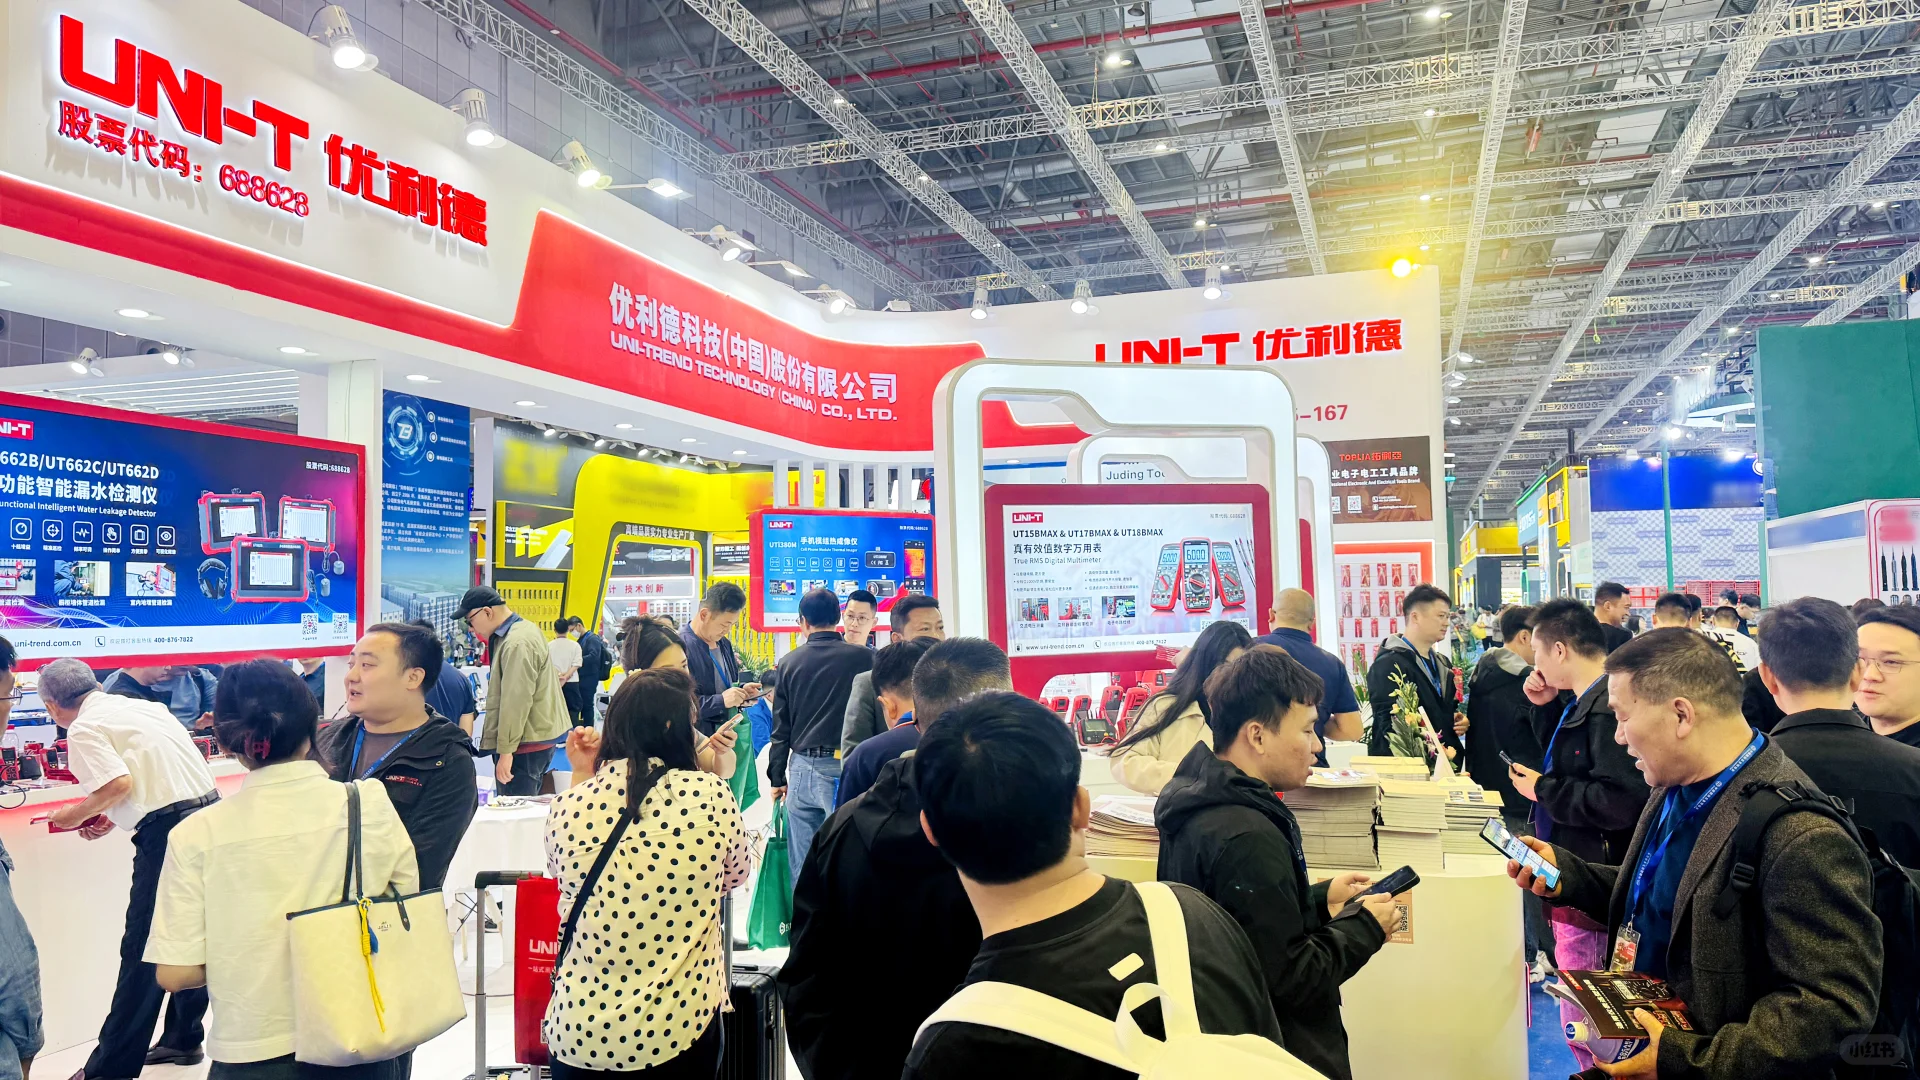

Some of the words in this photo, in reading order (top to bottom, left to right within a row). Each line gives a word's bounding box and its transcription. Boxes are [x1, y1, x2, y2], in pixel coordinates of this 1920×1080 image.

[59, 14, 309, 171] UNI-T
[219, 163, 309, 217] 688628
[323, 132, 487, 247] 优利德
[609, 281, 898, 404] 优利德科技(中国)股份有限公司
[1252, 319, 1403, 361] 优利德
[611, 331, 693, 373] UNI-TREND
[696, 359, 776, 400] TECHNOLOGY
[778, 386, 817, 415] (CHINA)
[821, 404, 854, 421] CO.,
[857, 407, 898, 421] LTD.
[1296, 404, 1348, 421] -167
[1339, 453, 1370, 462] TOPLIA
[1106, 469, 1144, 481] Juding
[1331, 465, 1419, 480] 业电子电工工具品牌
[37, 502, 76, 513] Intelligent
[99, 507, 128, 517] Leakage
[1013, 513, 1042, 523] UNI-T
[769, 521, 792, 529] UNI-T
[1013, 529, 1058, 538] UT15BMAX
[1060, 529, 1066, 537] &
[1068, 529, 1112, 538] UT17BMAX
[1113, 528, 1120, 537] &
[1121, 528, 1164, 537] UT18BMAX
[1013, 543, 1102, 555] 真有效值数字万用表
[1044, 556, 1065, 566] Digital
[1066, 556, 1102, 564] Multimeter
[625, 583, 664, 594] 技术创新
[14, 639, 82, 648] uni-trend.com.cn
